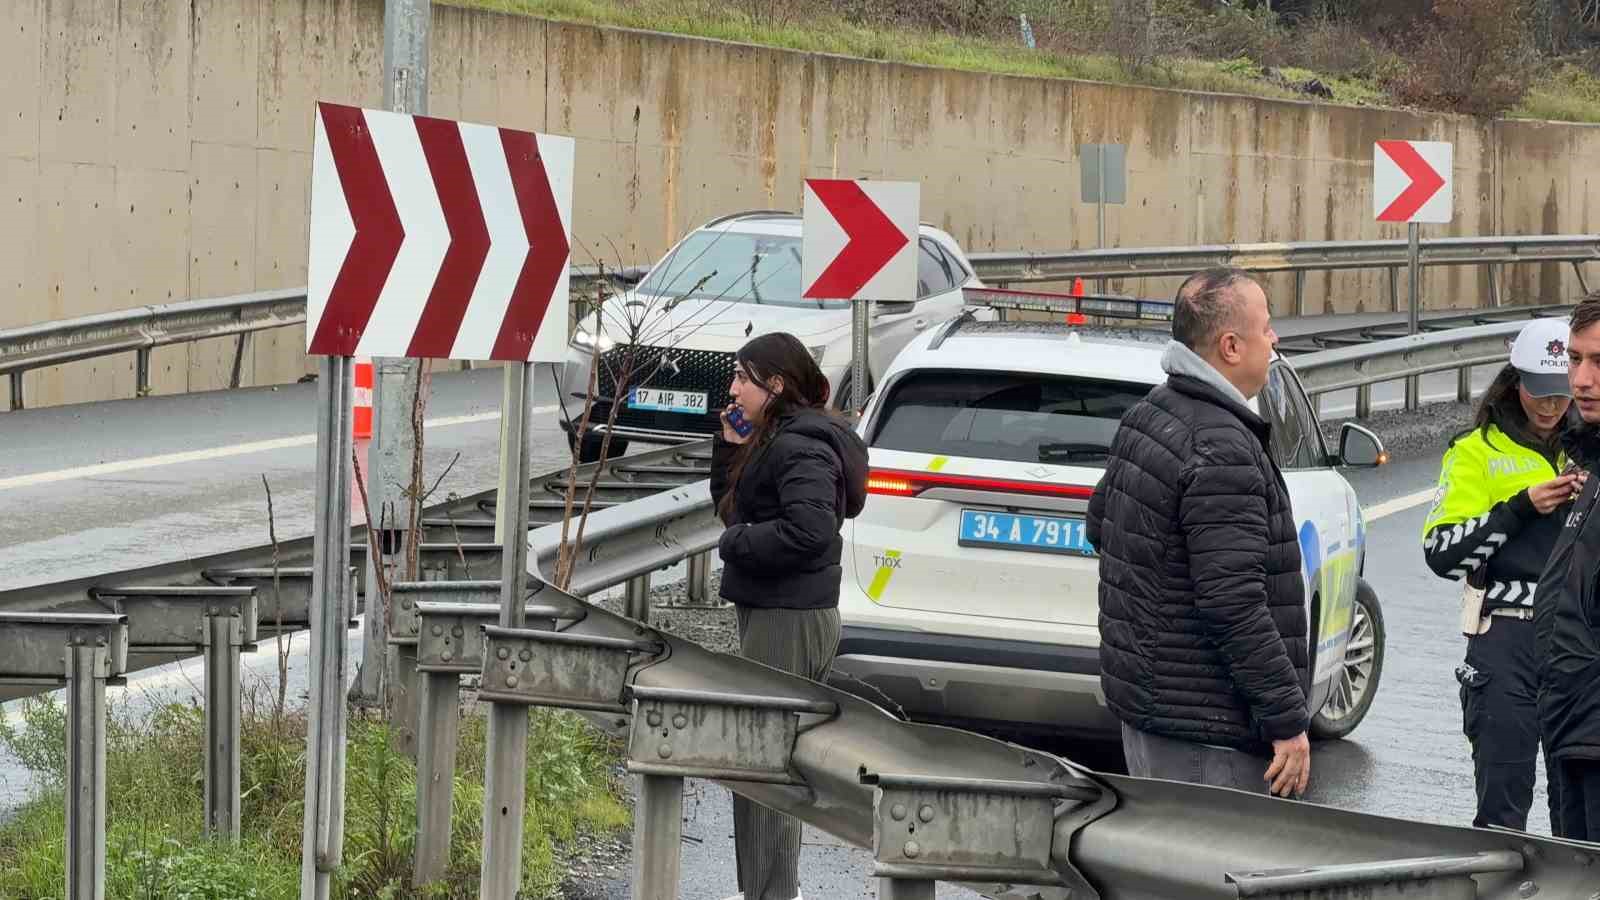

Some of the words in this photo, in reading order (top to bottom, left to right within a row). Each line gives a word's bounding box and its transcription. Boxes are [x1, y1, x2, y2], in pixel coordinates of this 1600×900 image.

[637, 391, 649, 404] 17
[657, 392, 675, 406] AIR
[683, 394, 704, 409] 382
[974, 515, 999, 539] 34
[1009, 518, 1022, 542] A
[1032, 520, 1086, 547] 7911
[873, 555, 902, 569] T10X
